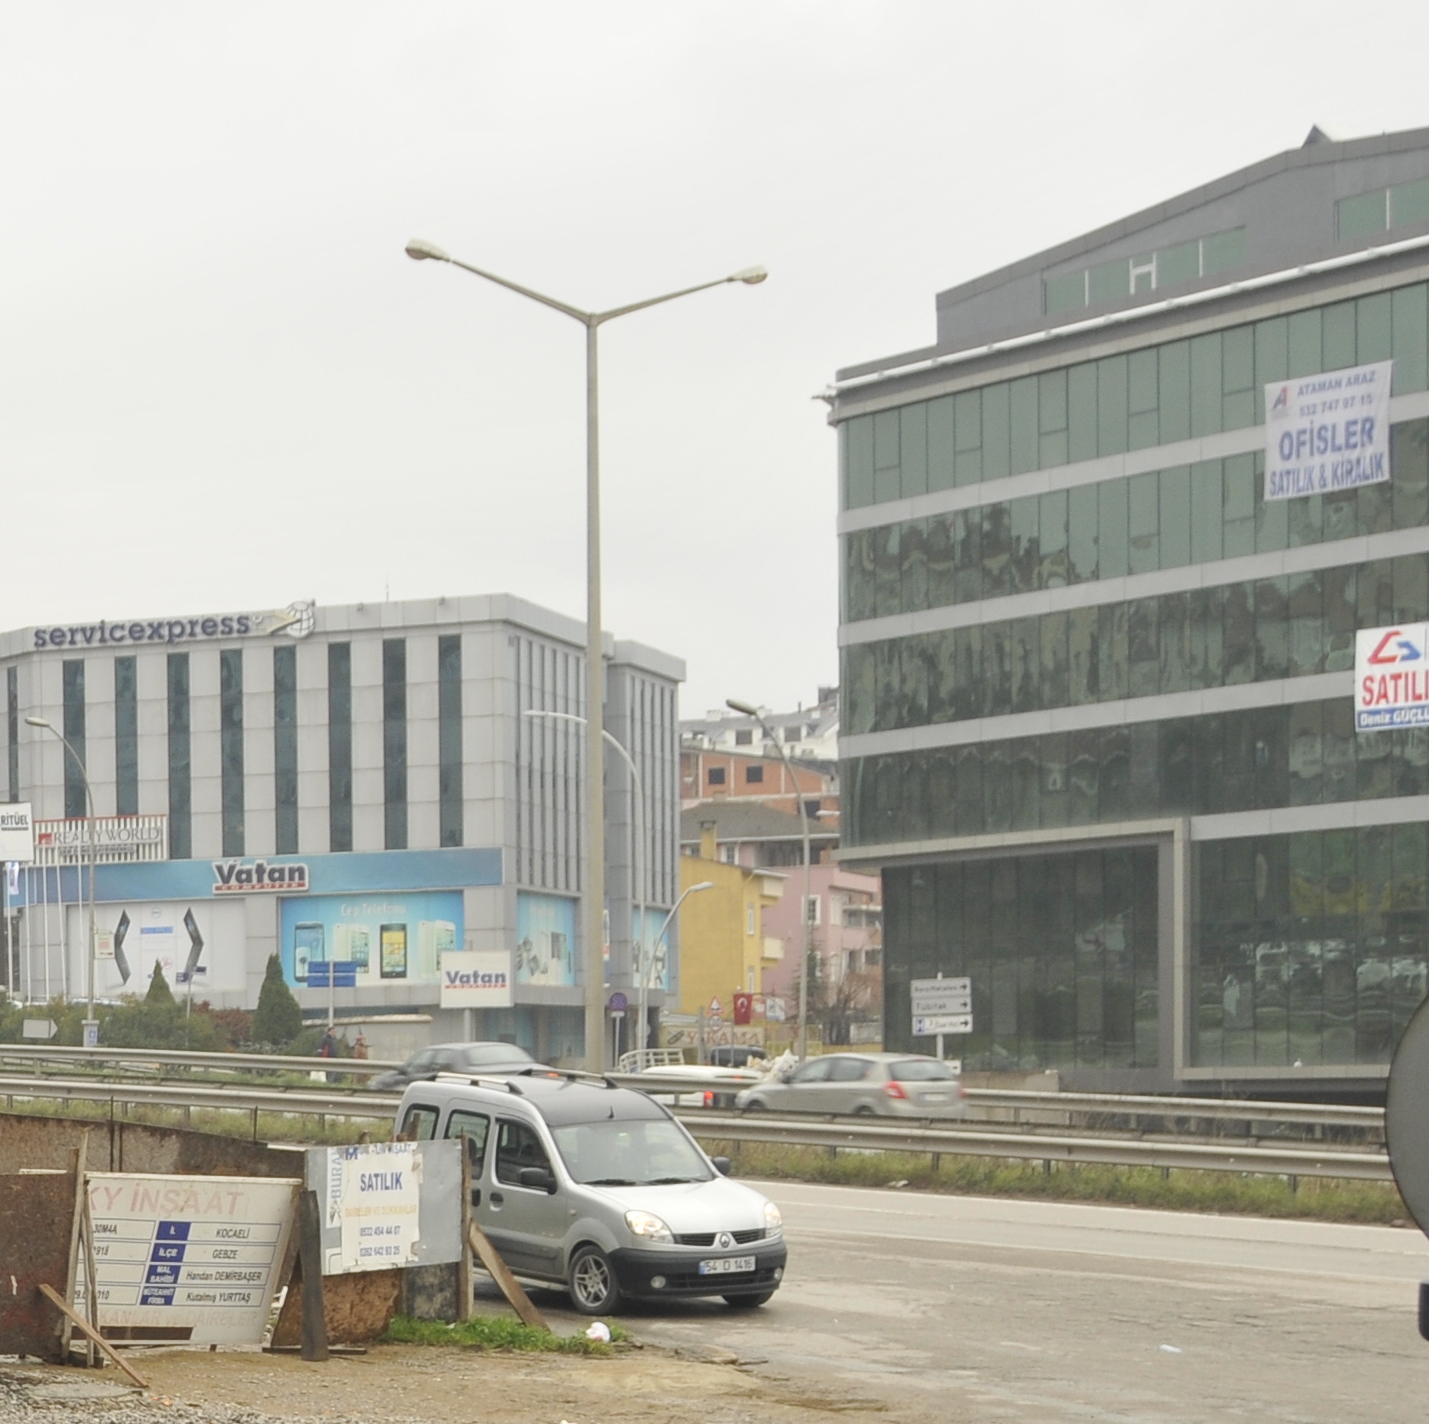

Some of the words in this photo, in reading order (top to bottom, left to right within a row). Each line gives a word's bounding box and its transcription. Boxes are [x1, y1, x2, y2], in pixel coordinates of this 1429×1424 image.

[1297, 379, 1342, 397] ATAMAN
[1345, 370, 1376, 387] ARAZ
[1278, 417, 1375, 461] OFİSLER
[1269, 465, 1315, 497] SATILIK
[34, 614, 251, 647] servicexpress
[1, 811, 29, 826] RİTÜEL
[106, 827, 160, 842] WORLD
[215, 862, 306, 884] Vatan
[445, 969, 507, 985] Vatan
[687, 1029, 761, 1045] YKAMA
[360, 1172, 403, 1192] SATILIK
[129, 1183, 244, 1218] İNŞAAT
[215, 1227, 250, 1239] KOCAELİ
[212, 1249, 239, 1260] GEBZE
[186, 1270, 214, 1281] Handan
[214, 1270, 263, 1285] DEMİRBAŞER
[218, 1291, 251, 1304] YURTTAŞ
